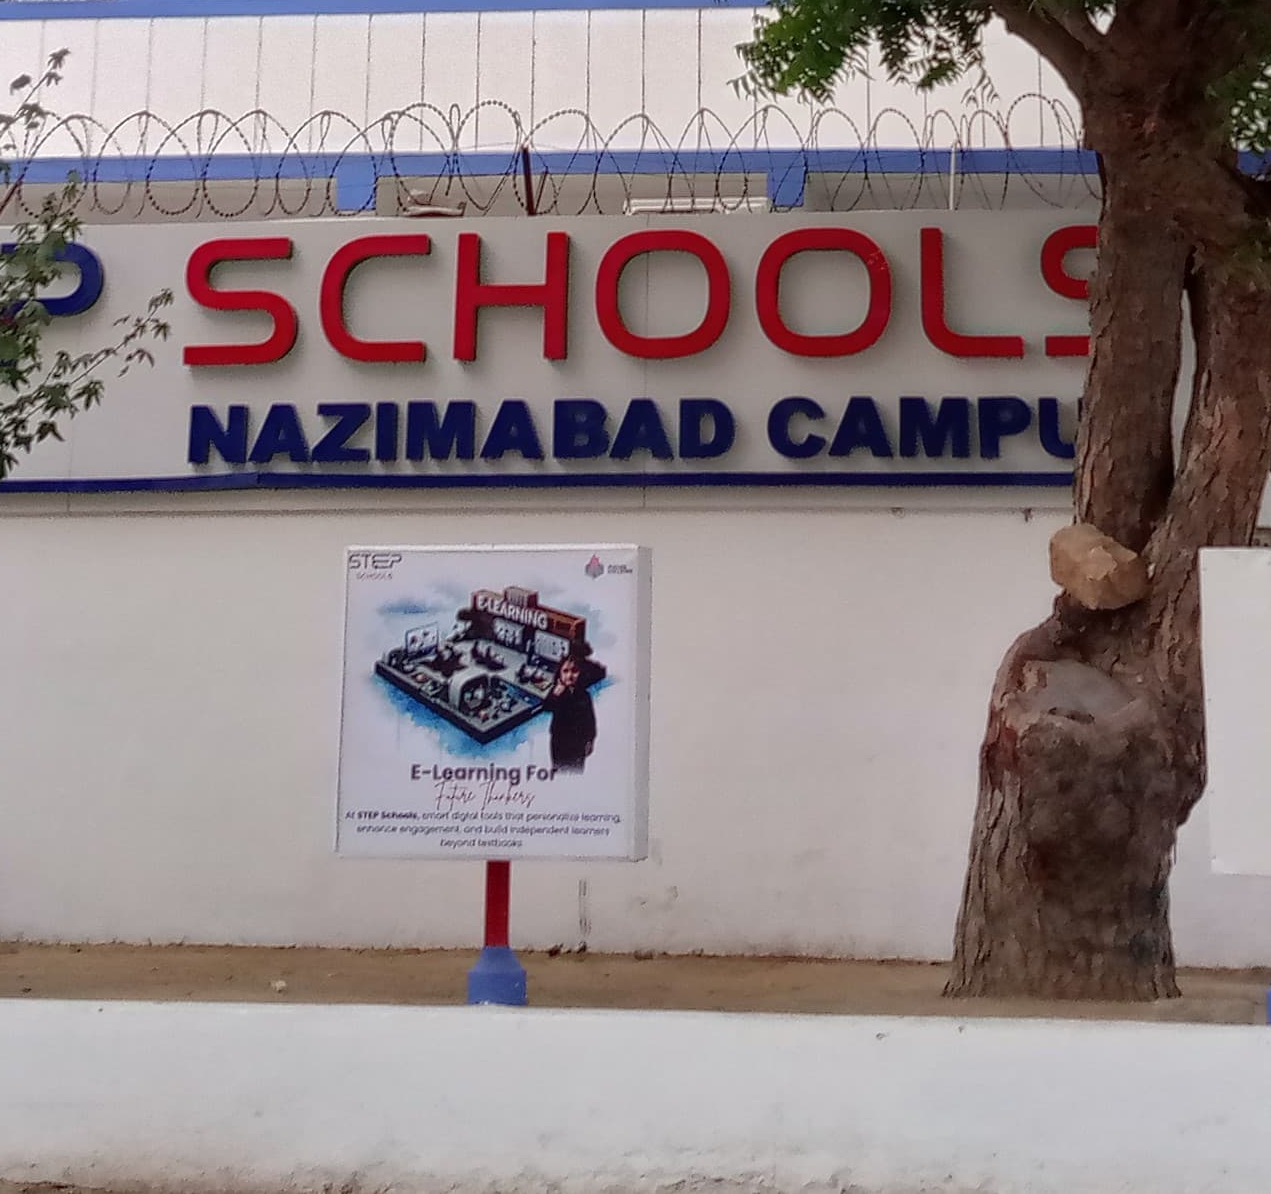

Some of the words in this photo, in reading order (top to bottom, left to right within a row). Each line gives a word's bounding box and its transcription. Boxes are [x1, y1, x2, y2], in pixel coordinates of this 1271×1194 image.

[186, 397, 736, 464] NAZIMABAD
[767, 396, 1083, 459] CAMPU
[348, 553, 402, 570] STEP
[477, 593, 549, 630] E-LEARNING
[410, 762, 521, 787] E-Learning
[526, 764, 559, 782] For
[357, 811, 379, 819] STEP
